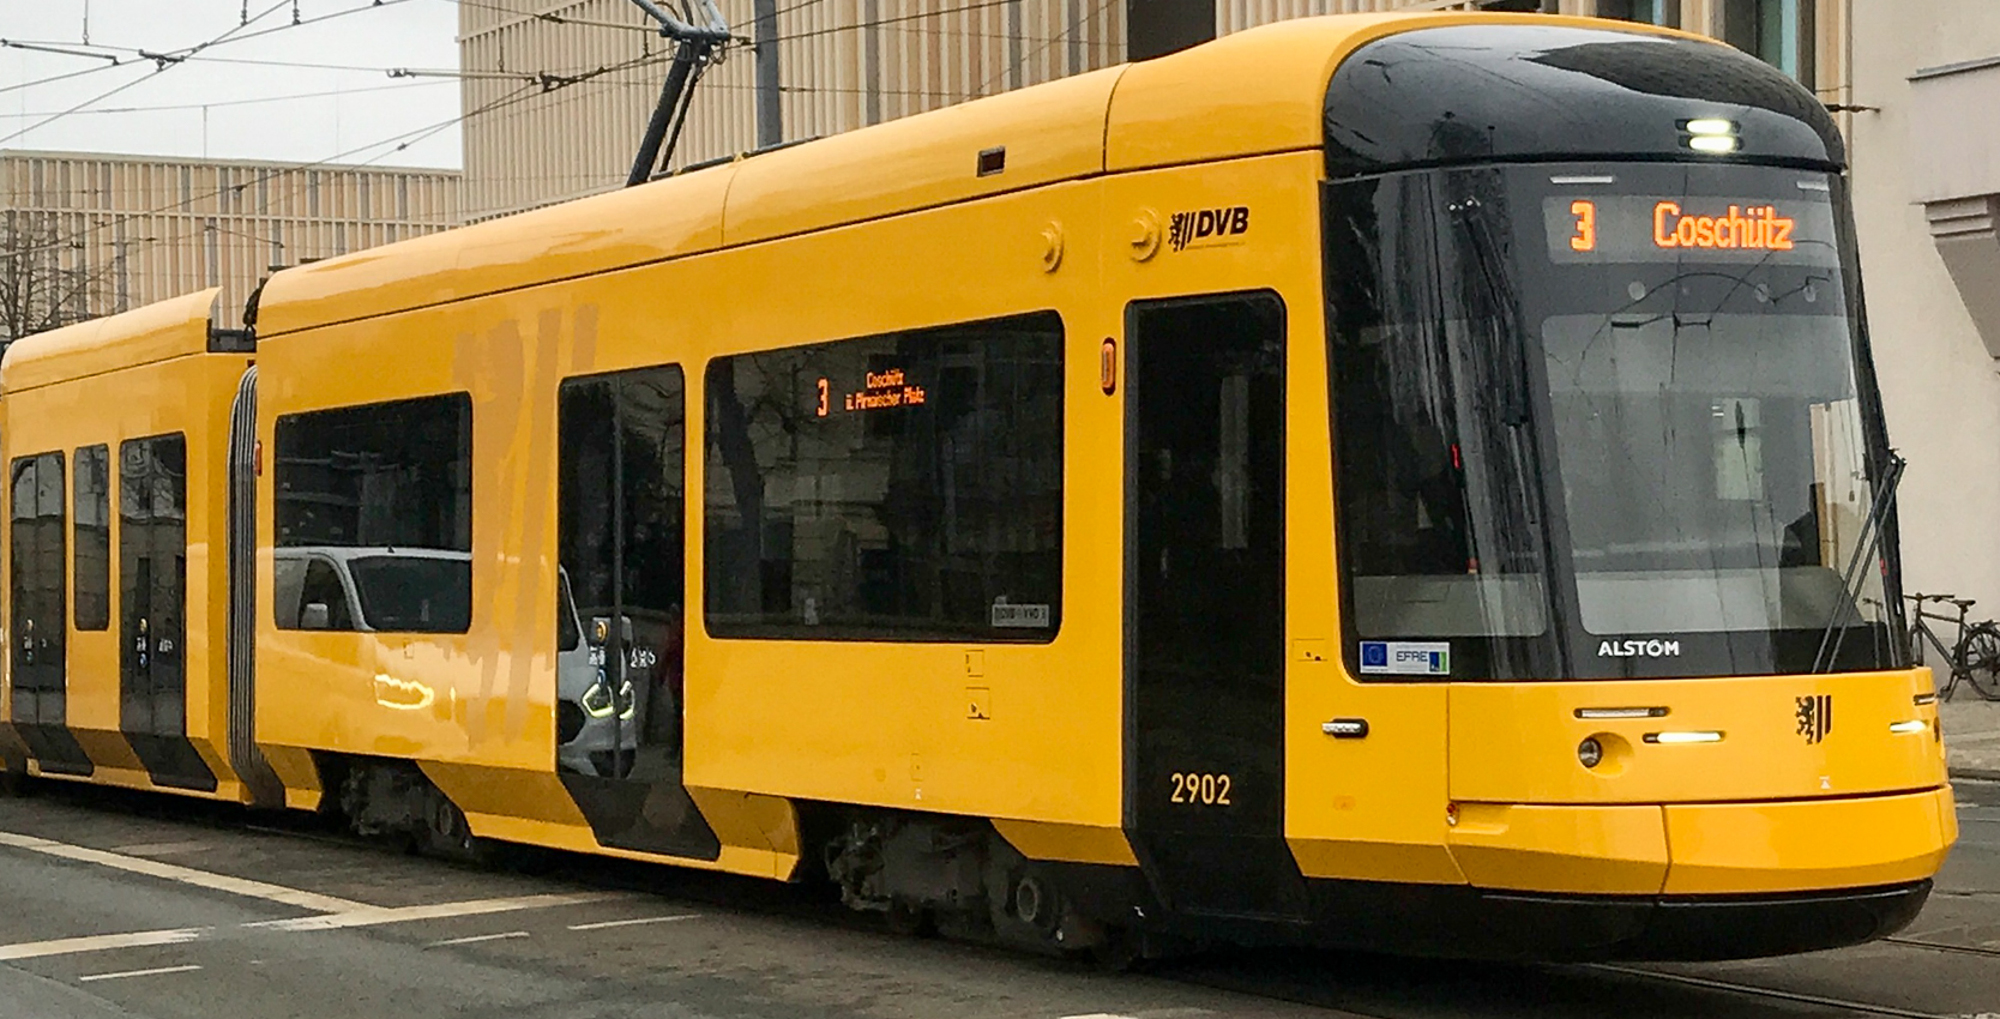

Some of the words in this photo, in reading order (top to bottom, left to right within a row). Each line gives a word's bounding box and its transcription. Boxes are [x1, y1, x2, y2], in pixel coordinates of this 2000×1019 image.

[1196, 207, 1249, 237] DVB
[1569, 200, 1595, 251] 3
[1653, 200, 1794, 250] Coschütz
[817, 378, 828, 416] 3
[1396, 651, 1429, 663] EFRE
[1598, 639, 1680, 657] ALSTOM
[1171, 772, 1231, 805] 2902
